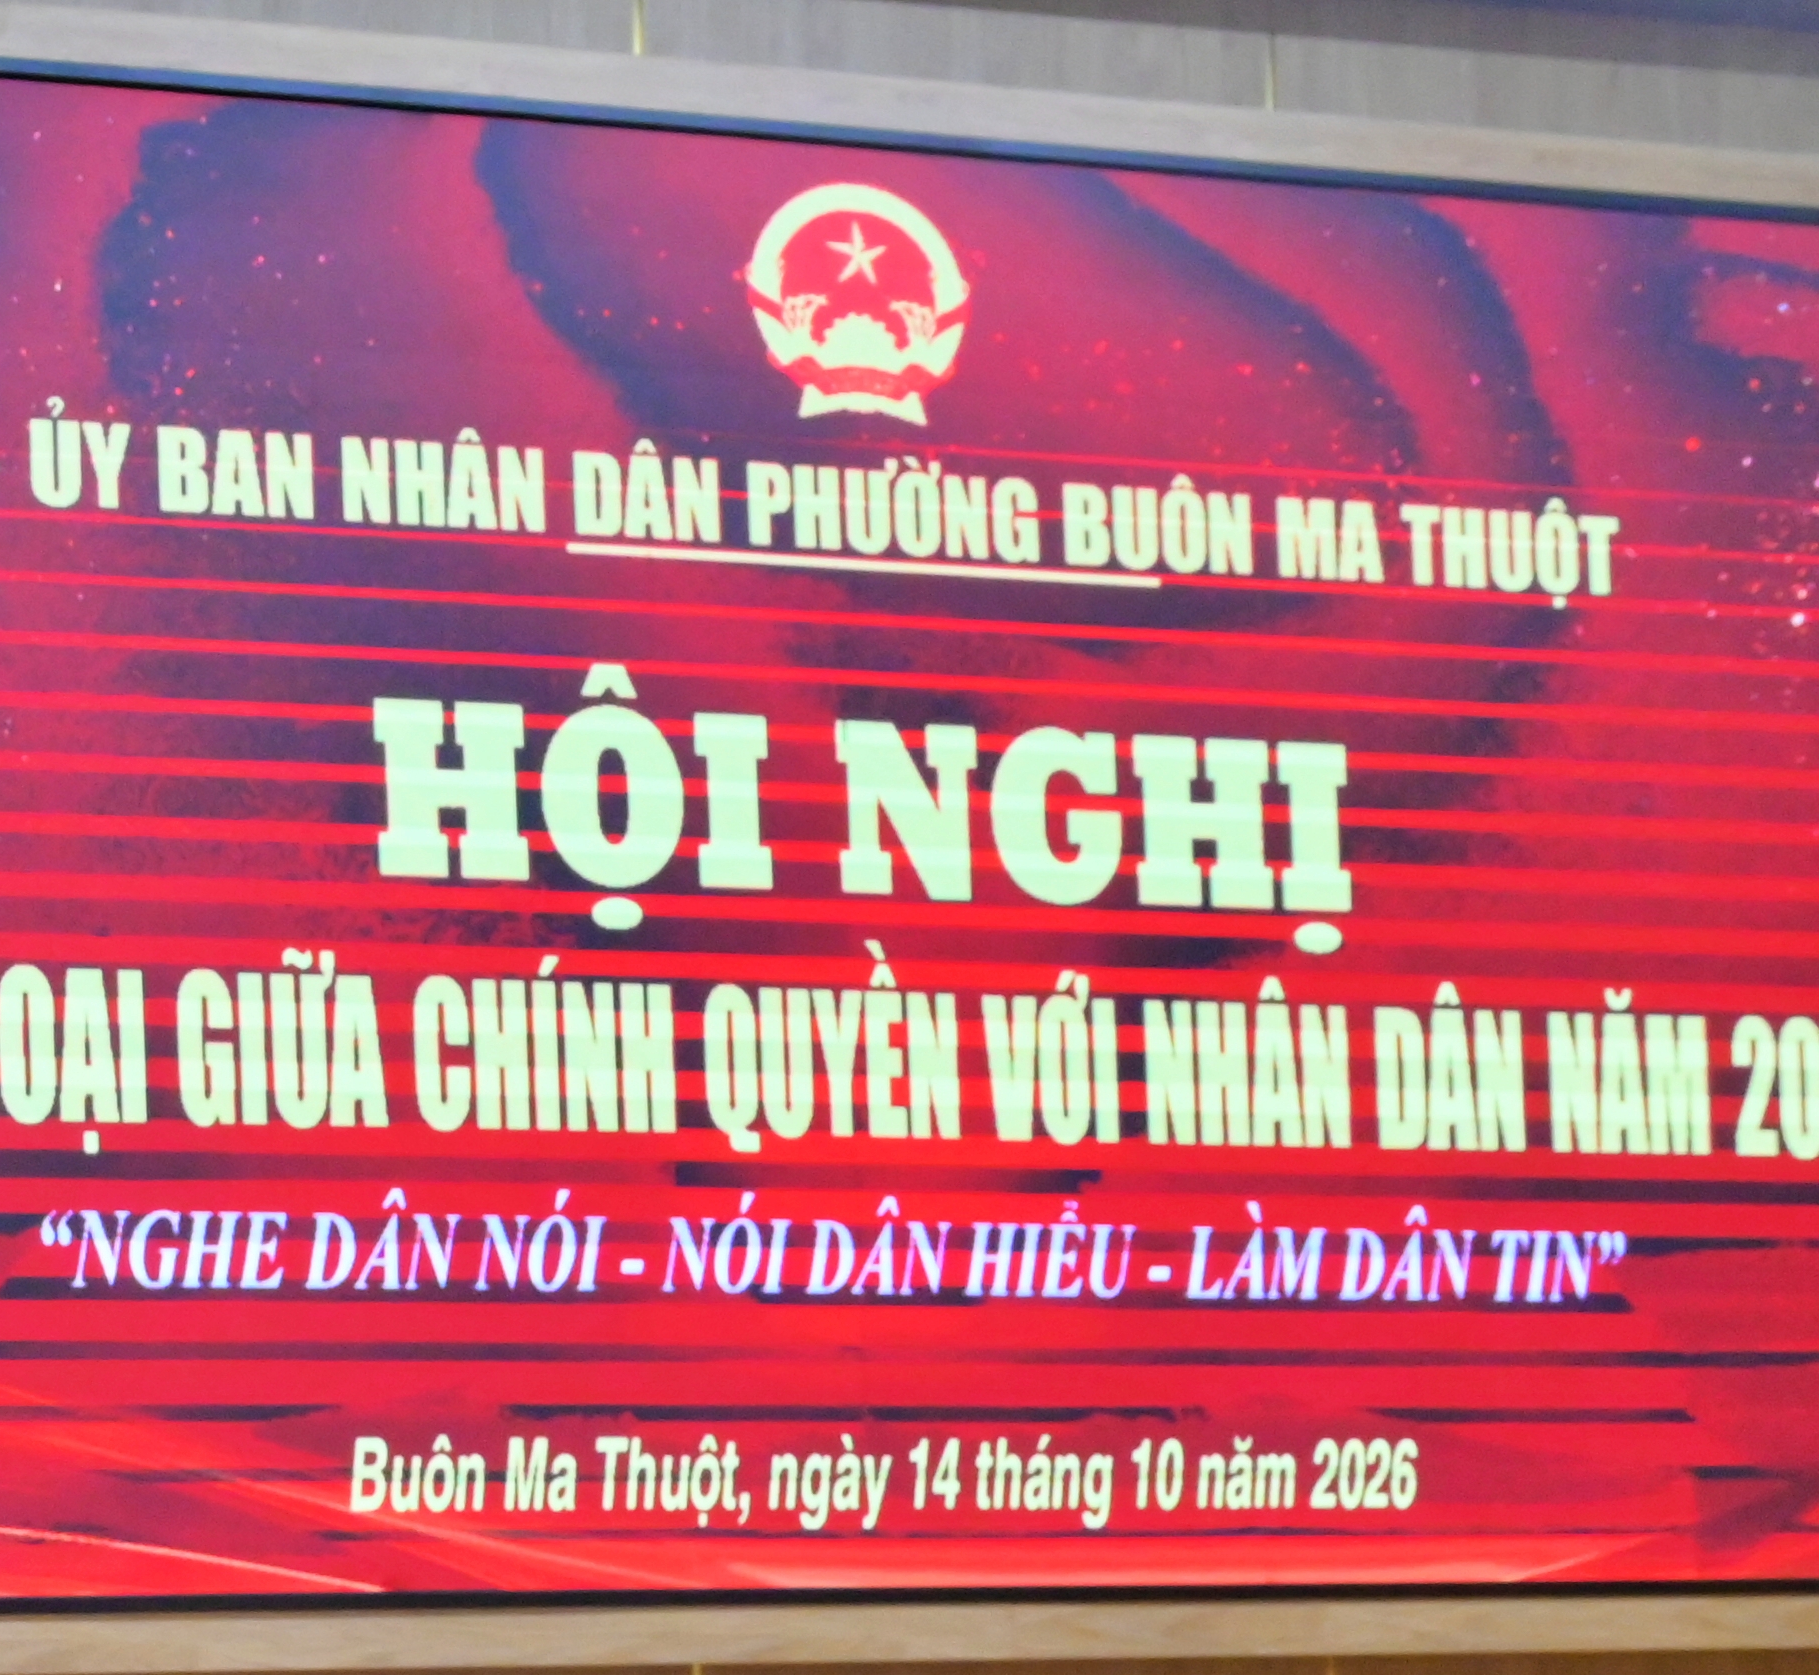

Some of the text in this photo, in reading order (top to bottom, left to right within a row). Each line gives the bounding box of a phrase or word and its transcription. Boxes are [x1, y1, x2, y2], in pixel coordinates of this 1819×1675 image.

[26, 394, 1622, 611] ỦY BAN NHÂN DÂN PHƯỜNG BUÔN MA THUỘT
[371, 661, 1354, 956] HỘI NGHỊ
[175, 946, 391, 1131] GIỮA
[411, 953, 678, 1135] CHÍNH
[702, 938, 962, 1155] QUYỀN
[980, 968, 1121, 1147] VỚI
[1141, 974, 1353, 1150] NHÂN
[1372, 980, 1528, 1154] DÂN
[1545, 986, 1713, 1157] NĂM
[39, 1208, 288, 1291] “NGHE
[304, 1186, 461, 1291] DÂN
[474, 1187, 606, 1293] NÓI
[661, 1190, 791, 1295] NÓI
[805, 1194, 951, 1297] DÂN
[1185, 1199, 1327, 1301] LÀM
[1338, 1203, 1476, 1303] DÂN
[1490, 1228, 1627, 1304] TIN”
[347, 1432, 1420, 1532] Buôn Ma Thuột, ngày 14 tháng 10 năm 2026
